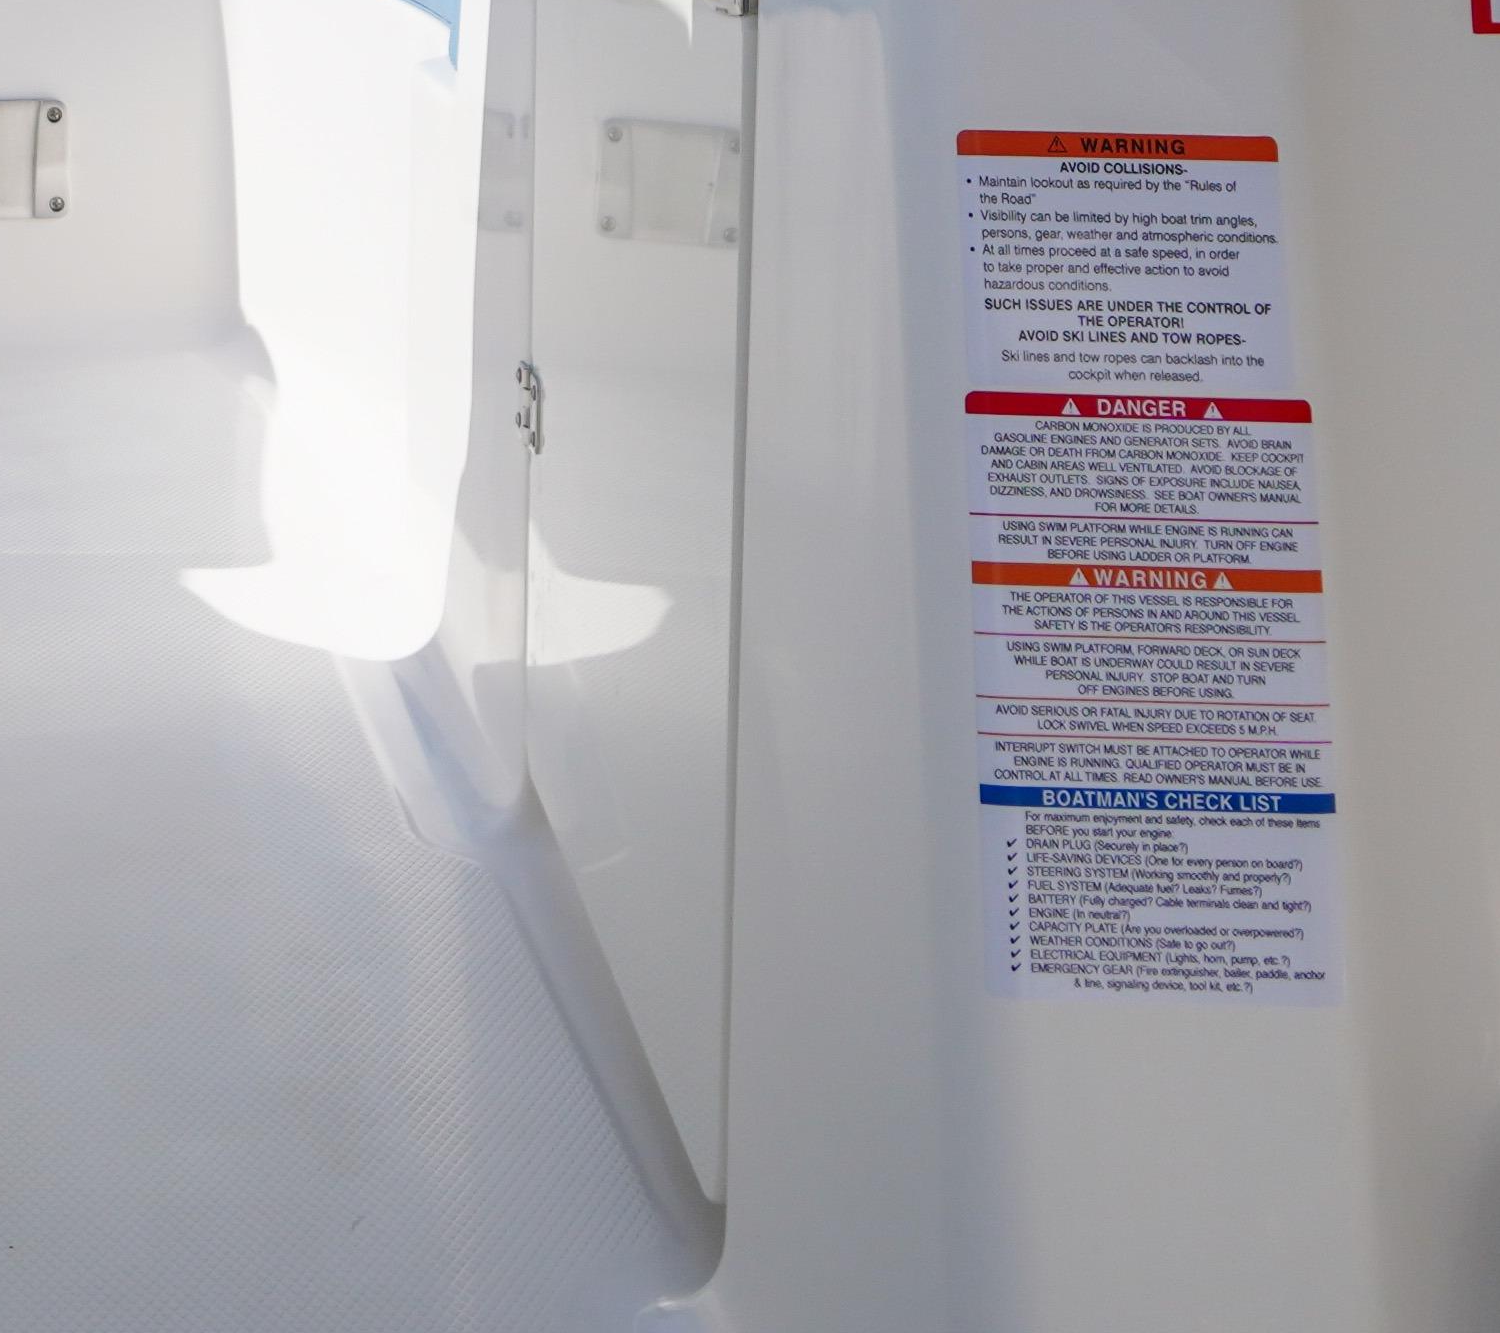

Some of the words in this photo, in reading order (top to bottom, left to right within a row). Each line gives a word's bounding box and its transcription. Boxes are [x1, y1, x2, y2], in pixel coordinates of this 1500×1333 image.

[1080, 138, 1186, 155] WARNING
[1060, 161, 1100, 174] AVOID
[978, 175, 1026, 188] Maintain
[1030, 176, 1073, 189] lookout
[1076, 179, 1090, 189] as
[1093, 178, 1142, 192] required
[1145, 179, 1159, 193] by
[1162, 178, 1181, 191] the
[1225, 180, 1236, 192] of
[979, 192, 997, 204] the
[980, 209, 1026, 224] Visibility
[1030, 212, 1051, 222] can
[1054, 211, 1069, 223] be
[1072, 211, 1111, 223] limited
[1114, 212, 1128, 226] by
[1132, 212, 1157, 227] high
[1160, 212, 1187, 225] boat
[1189, 213, 1212, 225] trim
[1215, 214, 1257, 229] angles,
[984, 297, 1021, 310] SUCH
[1025, 298, 1072, 311] ISSUES
[1077, 299, 1102, 311] ARE
[1107, 300, 1153, 312] UNDER
[1158, 301, 1183, 313] THE
[1186, 301, 1250, 315] CONTROL
[1253, 302, 1271, 315] OF
[1078, 314, 1103, 327] THE
[1107, 315, 1184, 329] OPERATOR!
[1018, 329, 1058, 342] AVOID
[1062, 330, 1084, 342] SKI
[1088, 330, 1126, 343] LINES
[1130, 331, 1158, 343] AND
[1163, 332, 1191, 344] TOW
[1096, 399, 1187, 417] DANGER
[1094, 501, 1117, 512] FOR
[1119, 502, 1151, 513] MORE
[1153, 502, 1199, 514] DETAILS.
[1002, 520, 1036, 531] USING
[1038, 521, 1067, 532] SWIM
[1069, 522, 1126, 534] PLATFORM
[1128, 524, 1161, 535] WHILE
[1164, 524, 1204, 536] ENGINE
[1207, 526, 1217, 537] IS
[1220, 526, 1269, 538] RUNNING
[1271, 527, 1293, 538] CAN
[1094, 569, 1207, 590] WARNING
[1077, 683, 1097, 695] OFF
[1101, 684, 1149, 696] ENGINES
[1152, 685, 1195, 698] BEFORE
[1197, 687, 1234, 699] USING.
[1042, 790, 1158, 808] BOATMAN'S
[1164, 792, 1233, 810] CHECK
[1239, 795, 1281, 812] LIST
[1028, 907, 1069, 922] ENGINE
[1072, 908, 1085, 921] (In
[1087, 909, 1130, 922] neutral?)
[1029, 934, 1082, 950] WEATHER
[1084, 936, 1153, 948] CONDITIONS
[1155, 937, 1181, 951] (Safe
[1183, 940, 1193, 949] to
[1195, 941, 1208, 952] go
[1210, 939, 1236, 952] out?)
